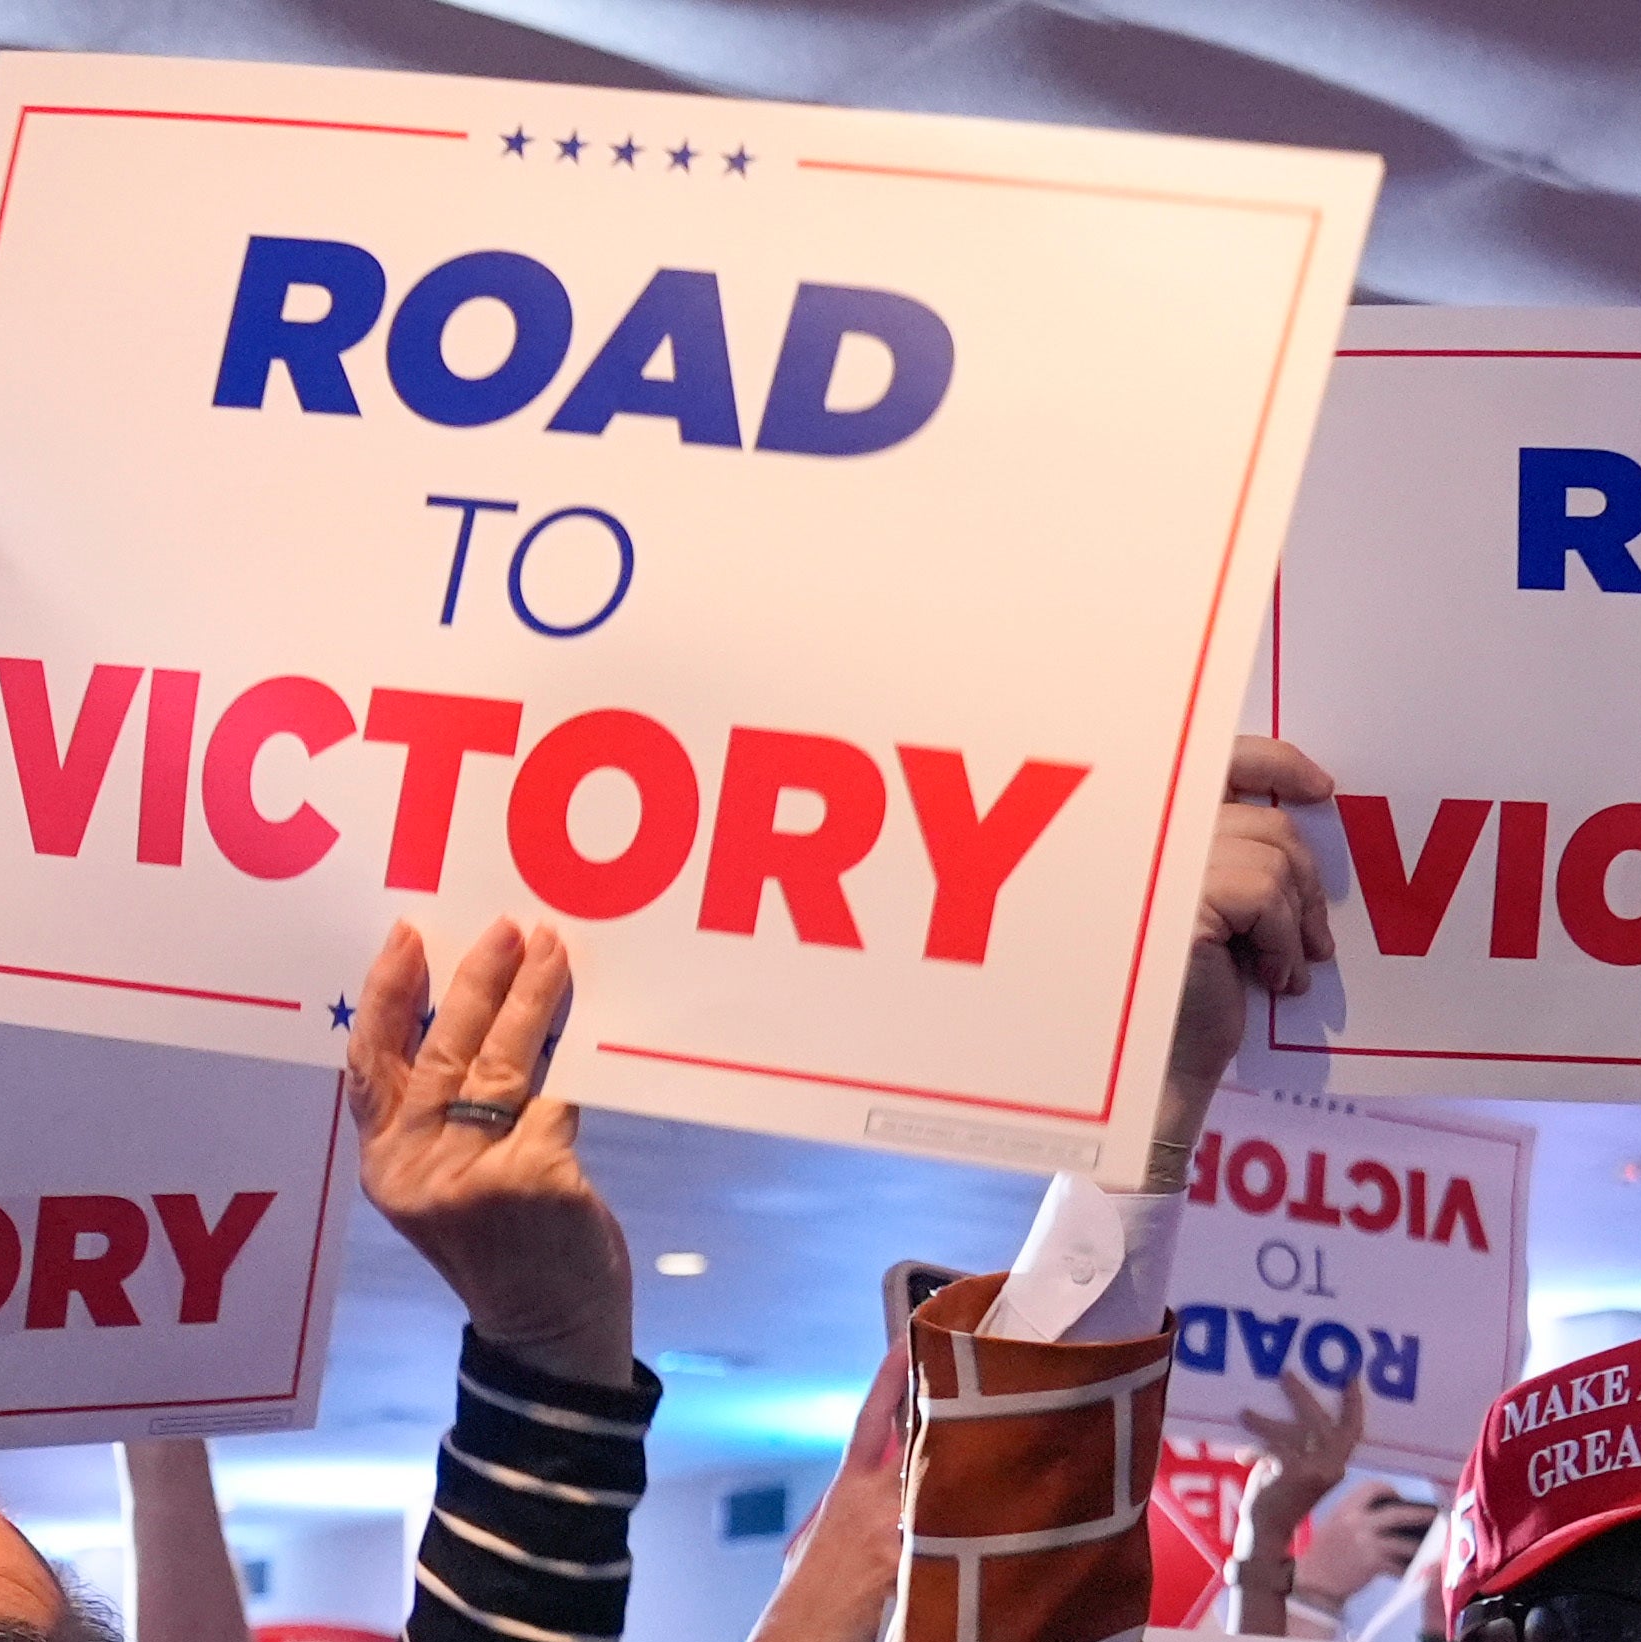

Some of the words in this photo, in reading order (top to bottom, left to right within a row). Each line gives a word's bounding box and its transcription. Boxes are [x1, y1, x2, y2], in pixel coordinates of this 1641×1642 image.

[212, 234, 956, 458] ROAD
[425, 494, 635, 639] TO
[1255, 1239, 1337, 1299] TO
[1175, 1304, 1420, 1404] ROAD
[1500, 1364, 1631, 1443] MAKE
